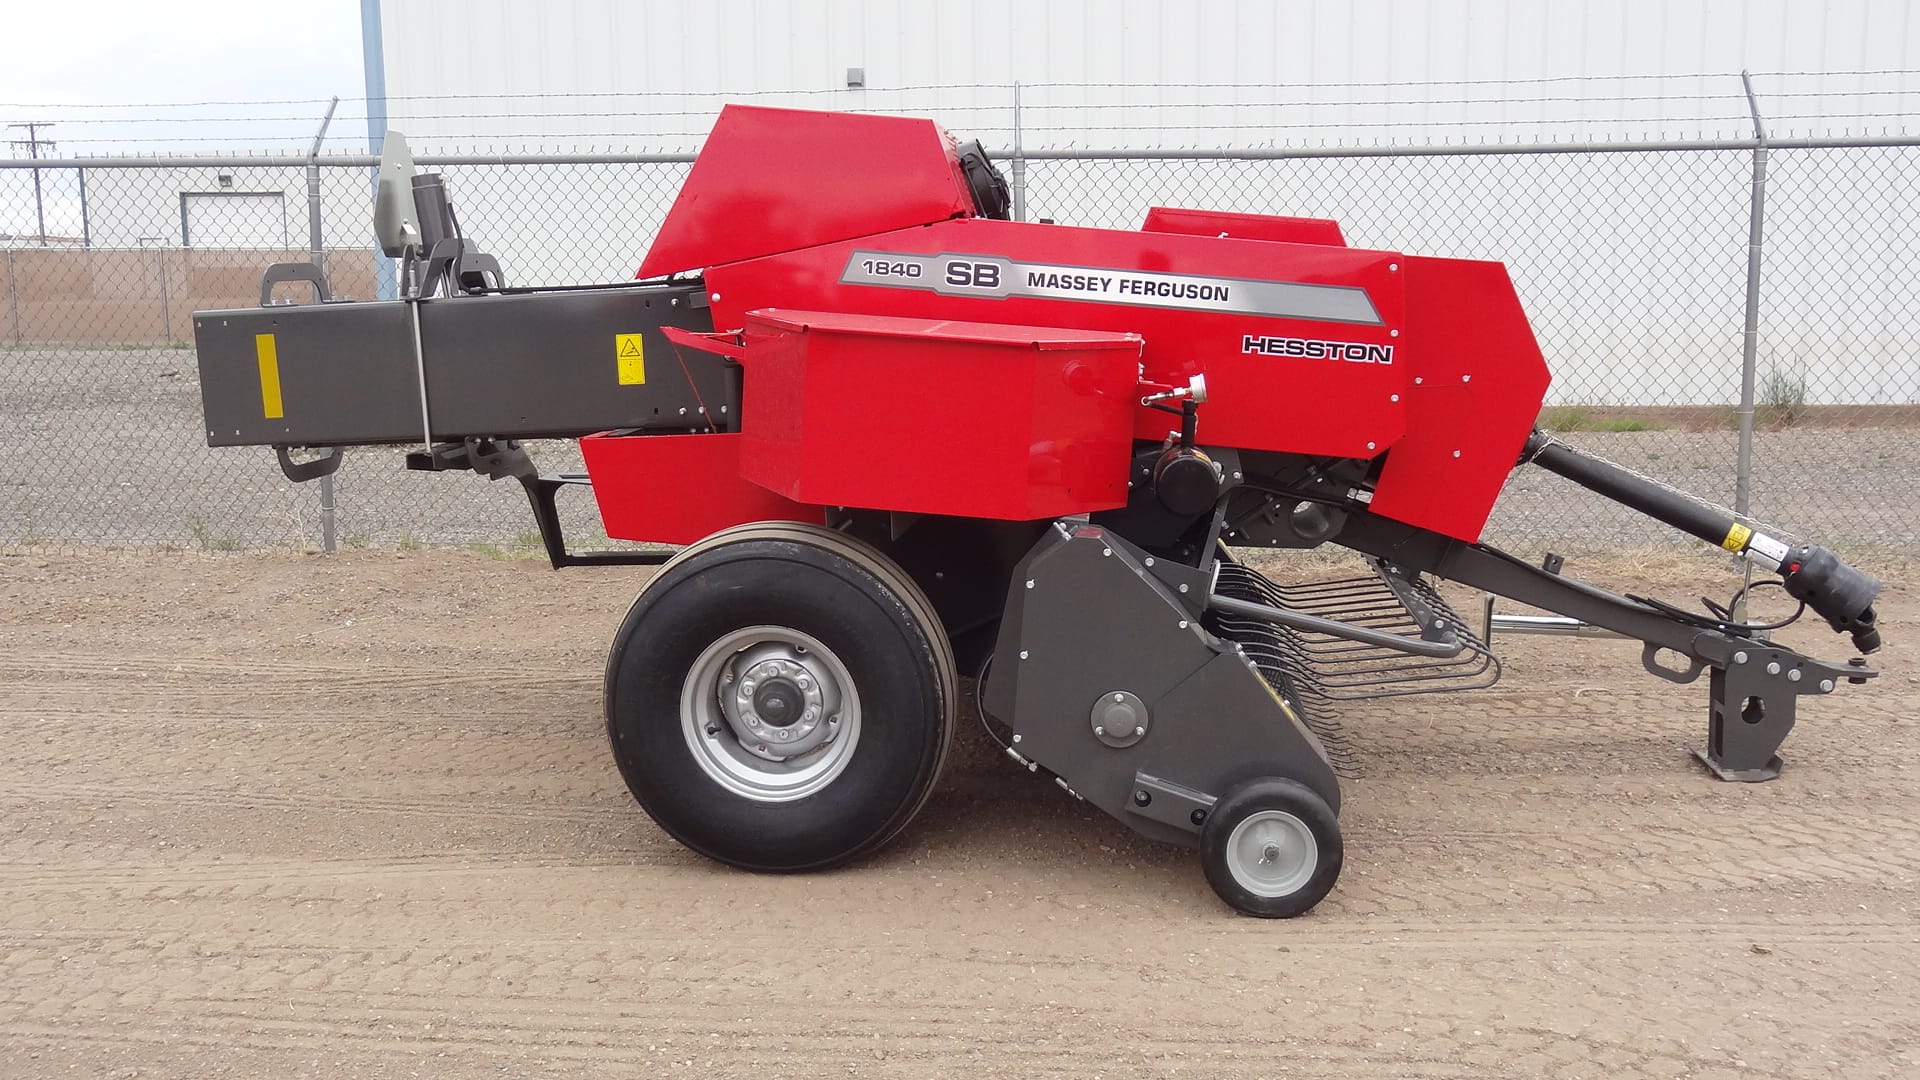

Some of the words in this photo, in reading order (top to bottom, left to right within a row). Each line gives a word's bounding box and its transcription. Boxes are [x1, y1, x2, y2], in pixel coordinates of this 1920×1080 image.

[862, 260, 922, 278] 1840
[946, 260, 1001, 288] SB
[1027, 272, 1112, 292] MASSEY
[1119, 279, 1230, 302] FERGUSON
[1242, 335, 1394, 364] HESSTON
